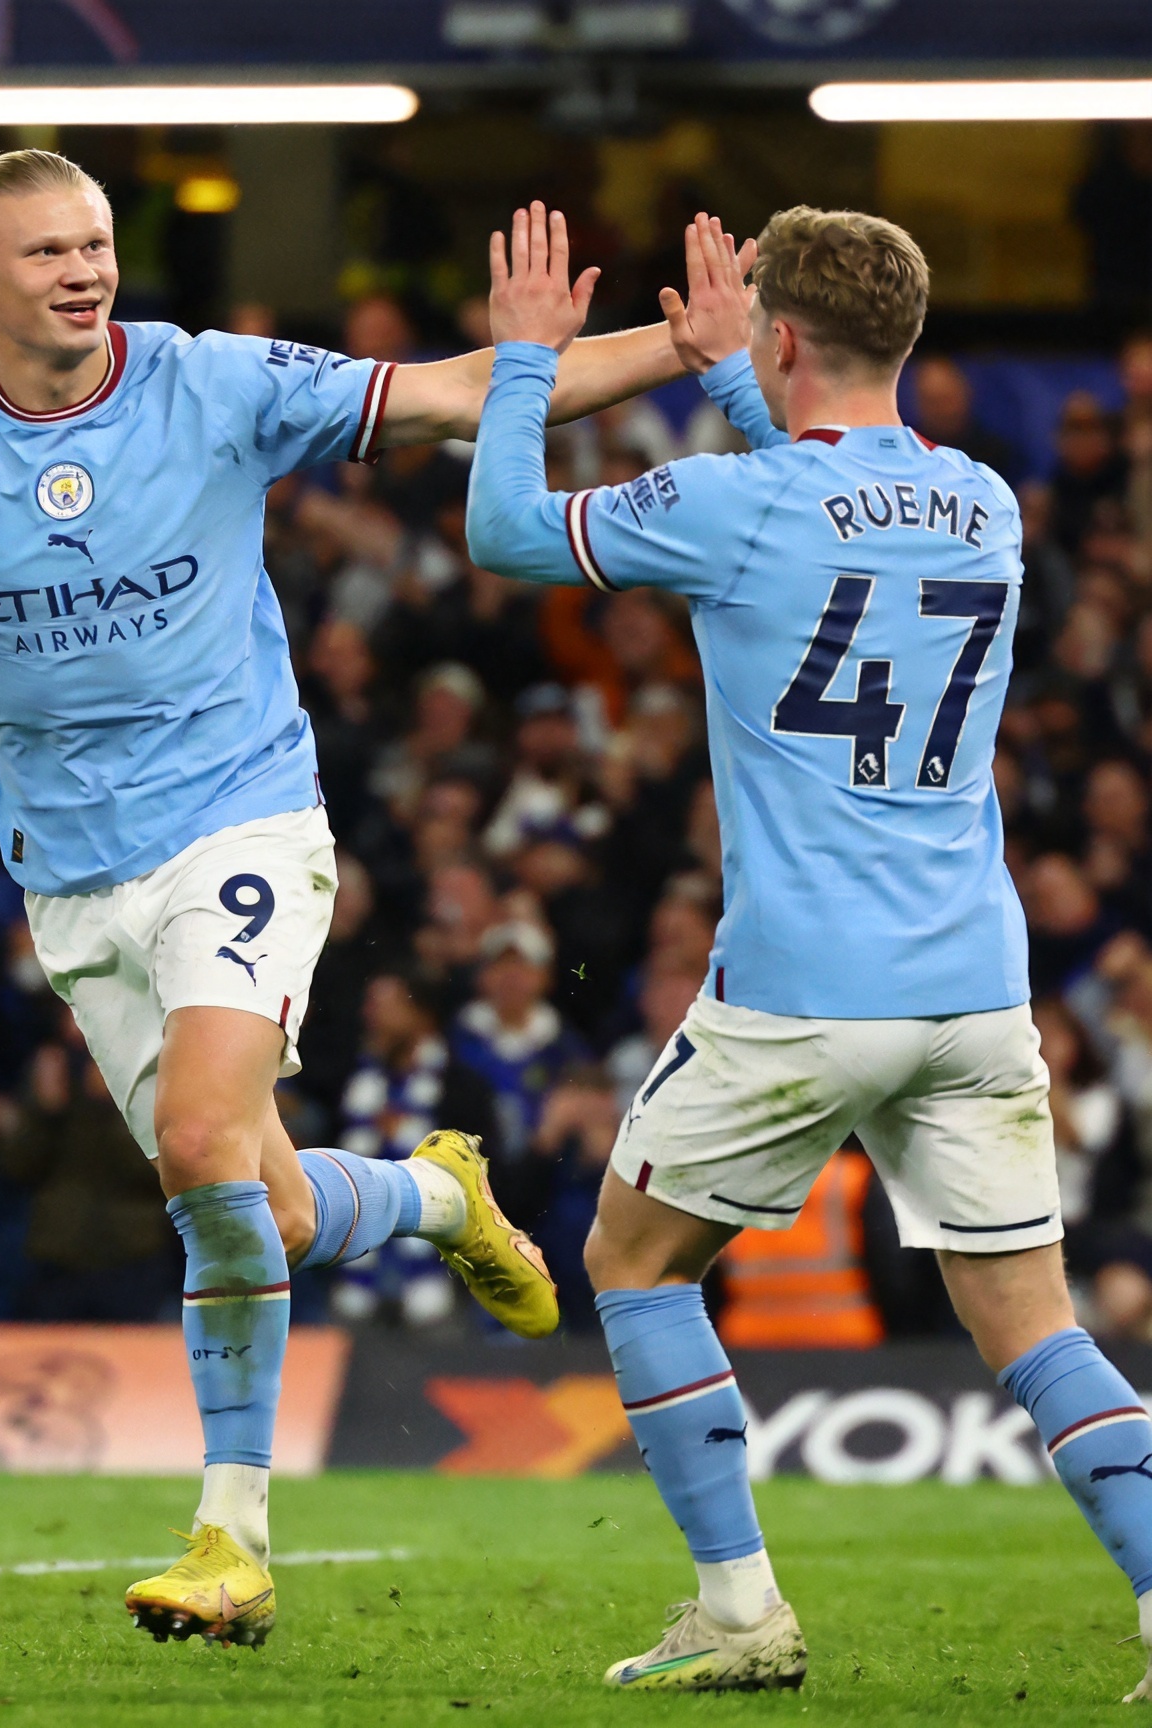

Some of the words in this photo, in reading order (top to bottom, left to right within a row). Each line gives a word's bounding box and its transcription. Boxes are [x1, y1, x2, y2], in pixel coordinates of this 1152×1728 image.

[820, 482, 990, 551] RUEME
[16, 608, 169, 655] AIRWAYS
[770, 572, 1010, 791] 47
[218, 872, 276, 944] 9
[744, 1387, 1060, 1488] YOK
